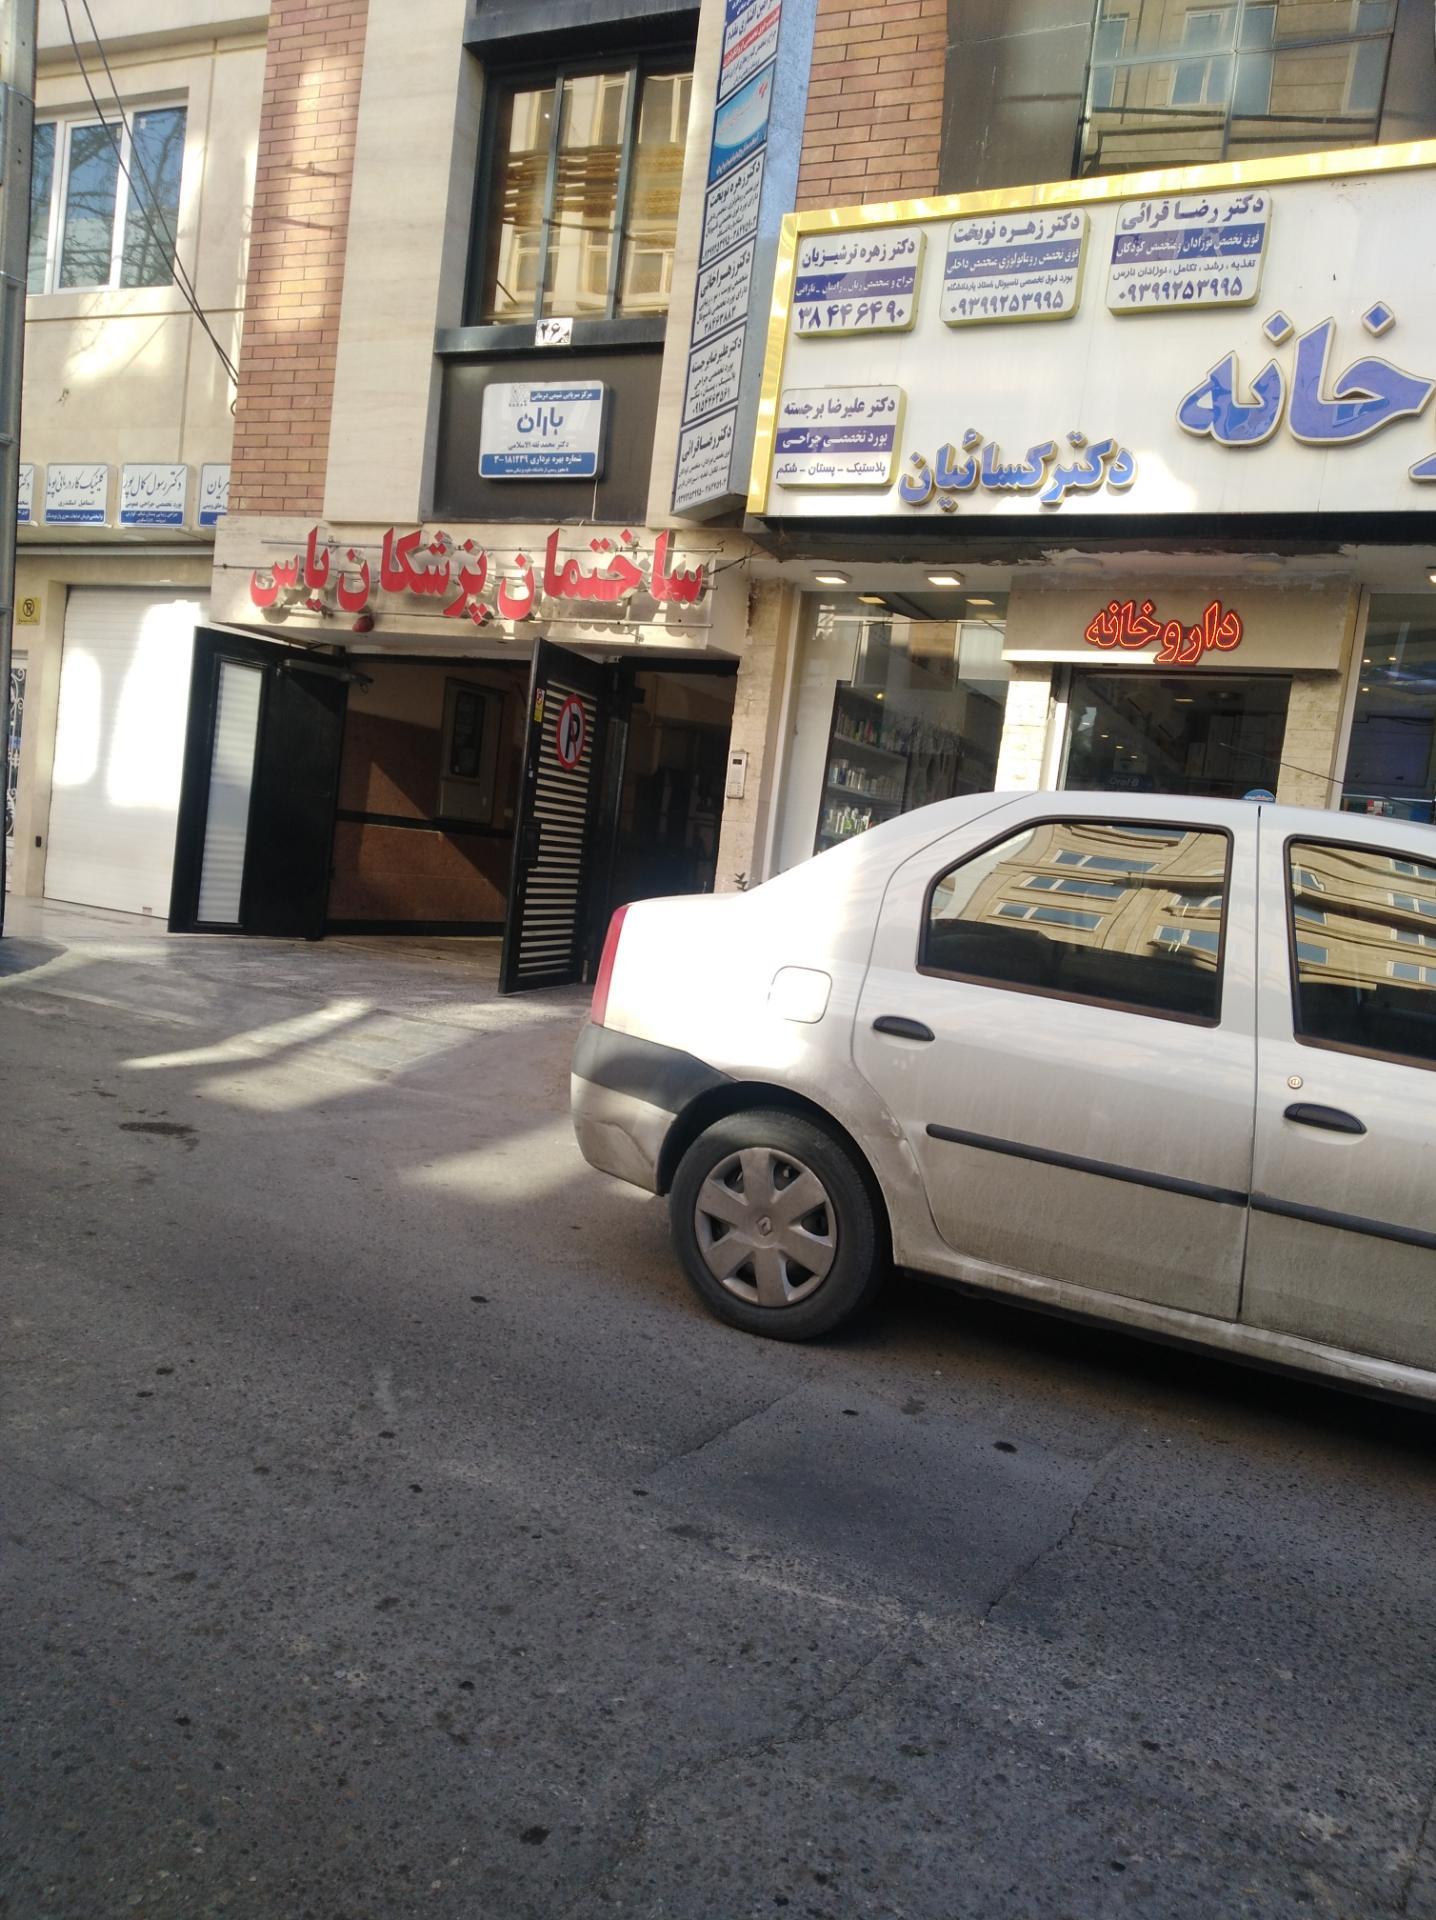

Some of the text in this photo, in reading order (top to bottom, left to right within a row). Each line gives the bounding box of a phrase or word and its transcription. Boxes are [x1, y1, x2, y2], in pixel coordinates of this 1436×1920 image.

[1121, 194, 1264, 230] دکتر رضا قرائی
[953, 212, 1080, 245] دکتر زهره نوبخت
[1183, 235, 1213, 252] نوزادان
[1215, 233, 1242, 248] تخصص
[1243, 230, 1260, 247] فوق
[860, 243, 887, 263] زهره
[888, 238, 915, 261] دکتر
[1064, 248, 1079, 263] فوق
[1116, 240, 1145, 257] کودکان
[947, 258, 969, 273] داخلی
[1174, 263, 1197, 276] تکامل
[1204, 262, 1224, 273] رشد
[896, 276, 914, 289] جراح
[1045, 275, 1058, 285] فوق
[1119, 276, 1243, 302] ۰۹۳۹۹۲۵۳۹۹۵
[950, 290, 1064, 316] ۰۹۳۹۹۲۵۳۹۹۵
[581, 391, 593, 400] مرکز
[784, 396, 895, 419] دکتر علیرضا برجسته
[516, 406, 563, 436] باران
[556, 441, 569, 450] دکتر
[782, 430, 888, 448] بورد تخصصی جراحی
[530, 455, 551, 465] برداری
[551, 456, 564, 465] بهره
[566, 454, 582, 465] شماره
[776, 461, 886, 479] پلاستیک پستان شکم
[898, 428, 1138, 512] دکتر کسائیان
[80, 466, 108, 495] کلینیک
[124, 476, 134, 499] پور
[146, 473, 166, 496] رسول
[163, 467, 185, 496] دکتر
[250, 525, 706, 627] ساختمان پزشکان یاس
[1085, 599, 1243, 666] داروخانه
